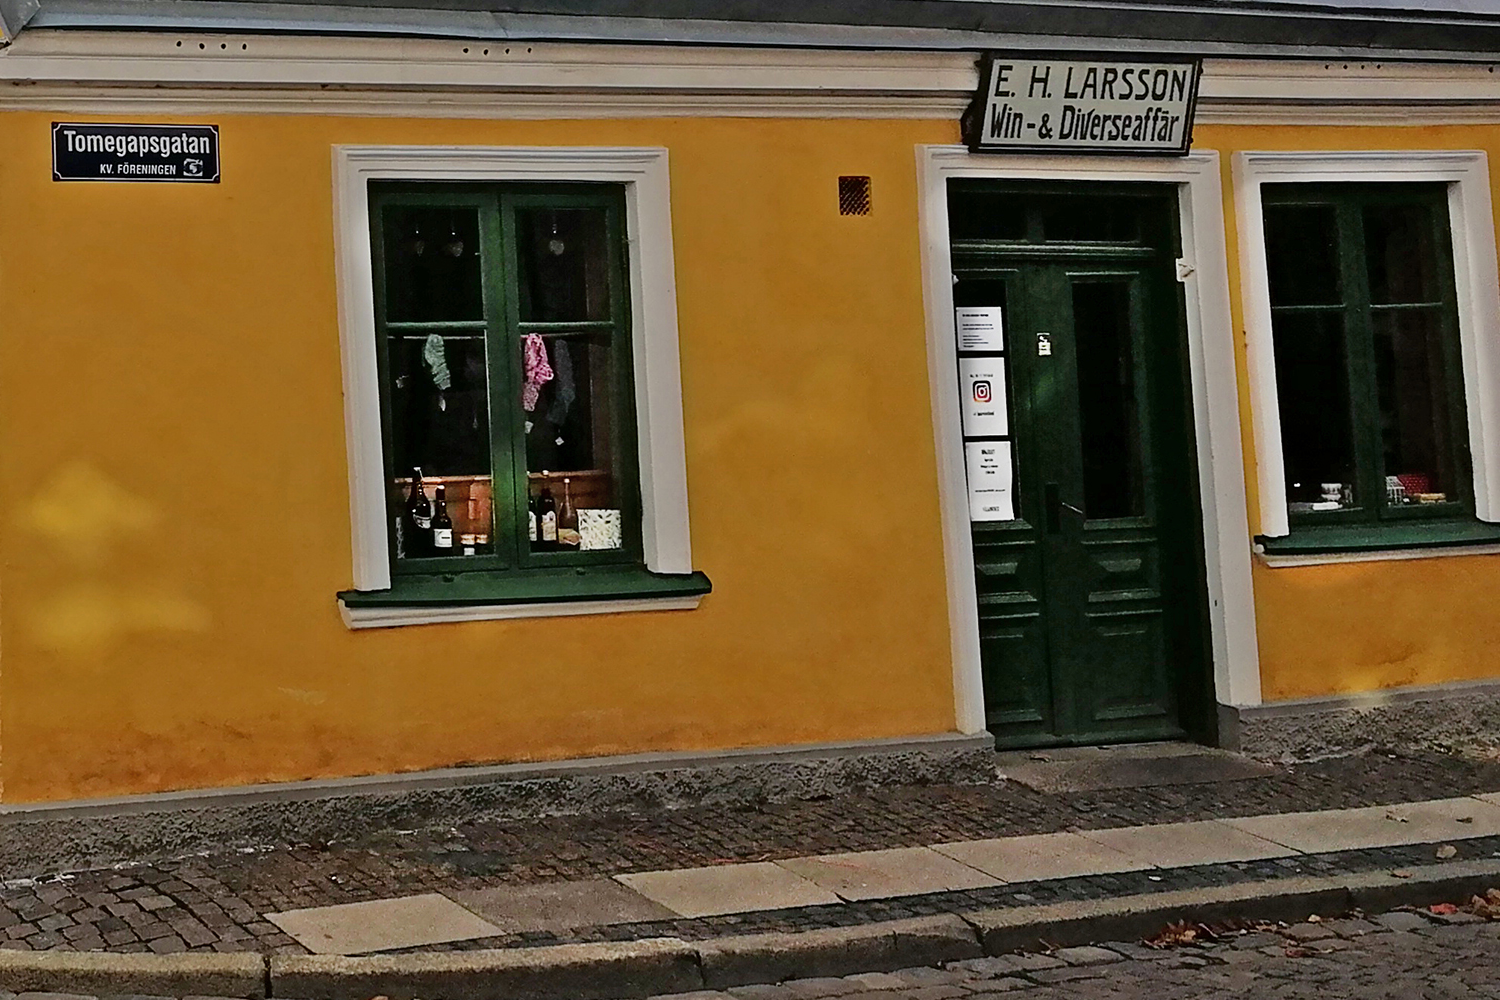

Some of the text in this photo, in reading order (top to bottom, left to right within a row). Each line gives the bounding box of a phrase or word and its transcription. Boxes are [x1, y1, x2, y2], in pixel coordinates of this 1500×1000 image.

[993, 64, 1188, 102] E. H. LARSSON
[1058, 104, 1181, 143] Diverseaffär
[63, 130, 211, 158] Tomegapsgatan
[99, 162, 177, 176] KV. FÖRENINGEN
